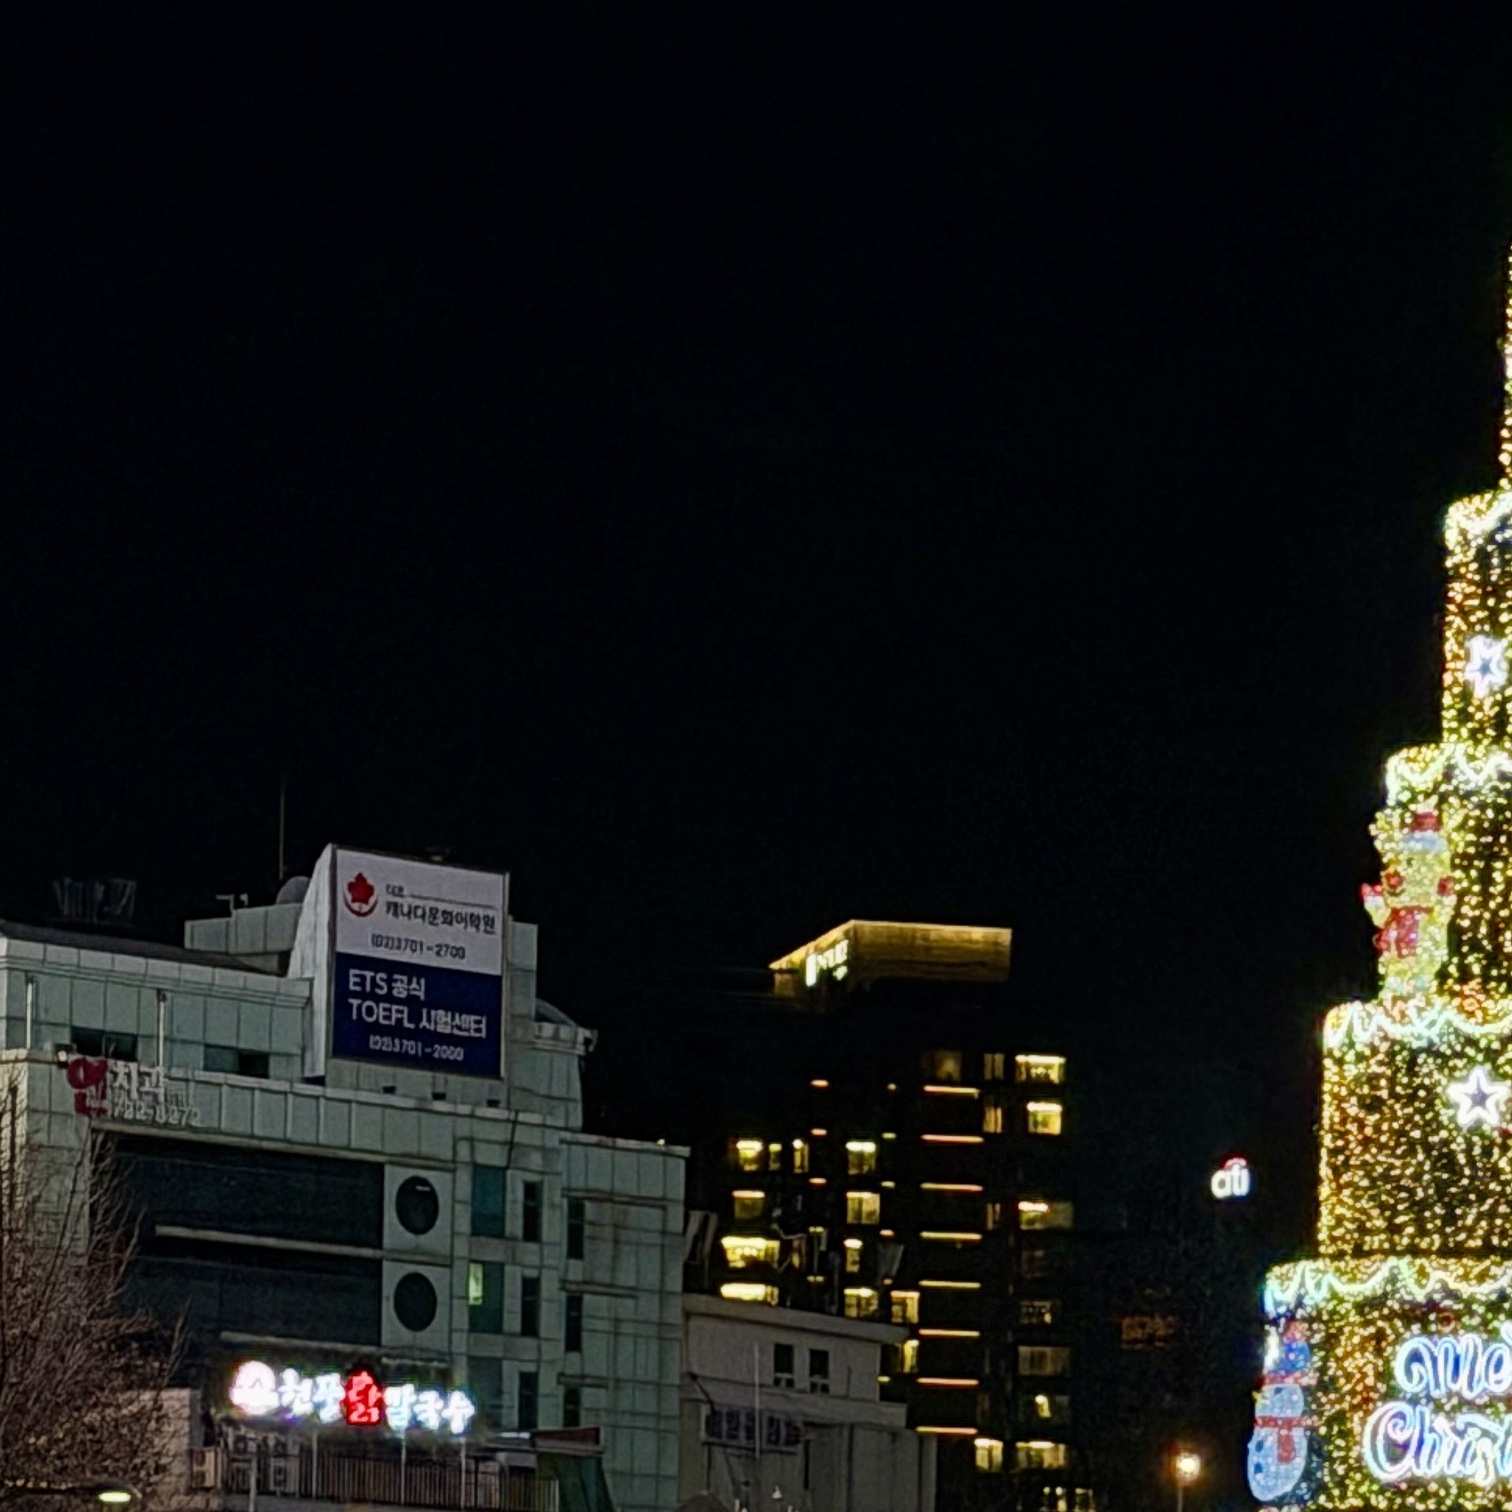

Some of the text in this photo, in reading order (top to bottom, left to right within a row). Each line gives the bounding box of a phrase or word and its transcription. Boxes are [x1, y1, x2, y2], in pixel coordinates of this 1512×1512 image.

[348, 969, 425, 1001] ETS 공식
[348, 998, 486, 1038] TOEFL 시험센터
